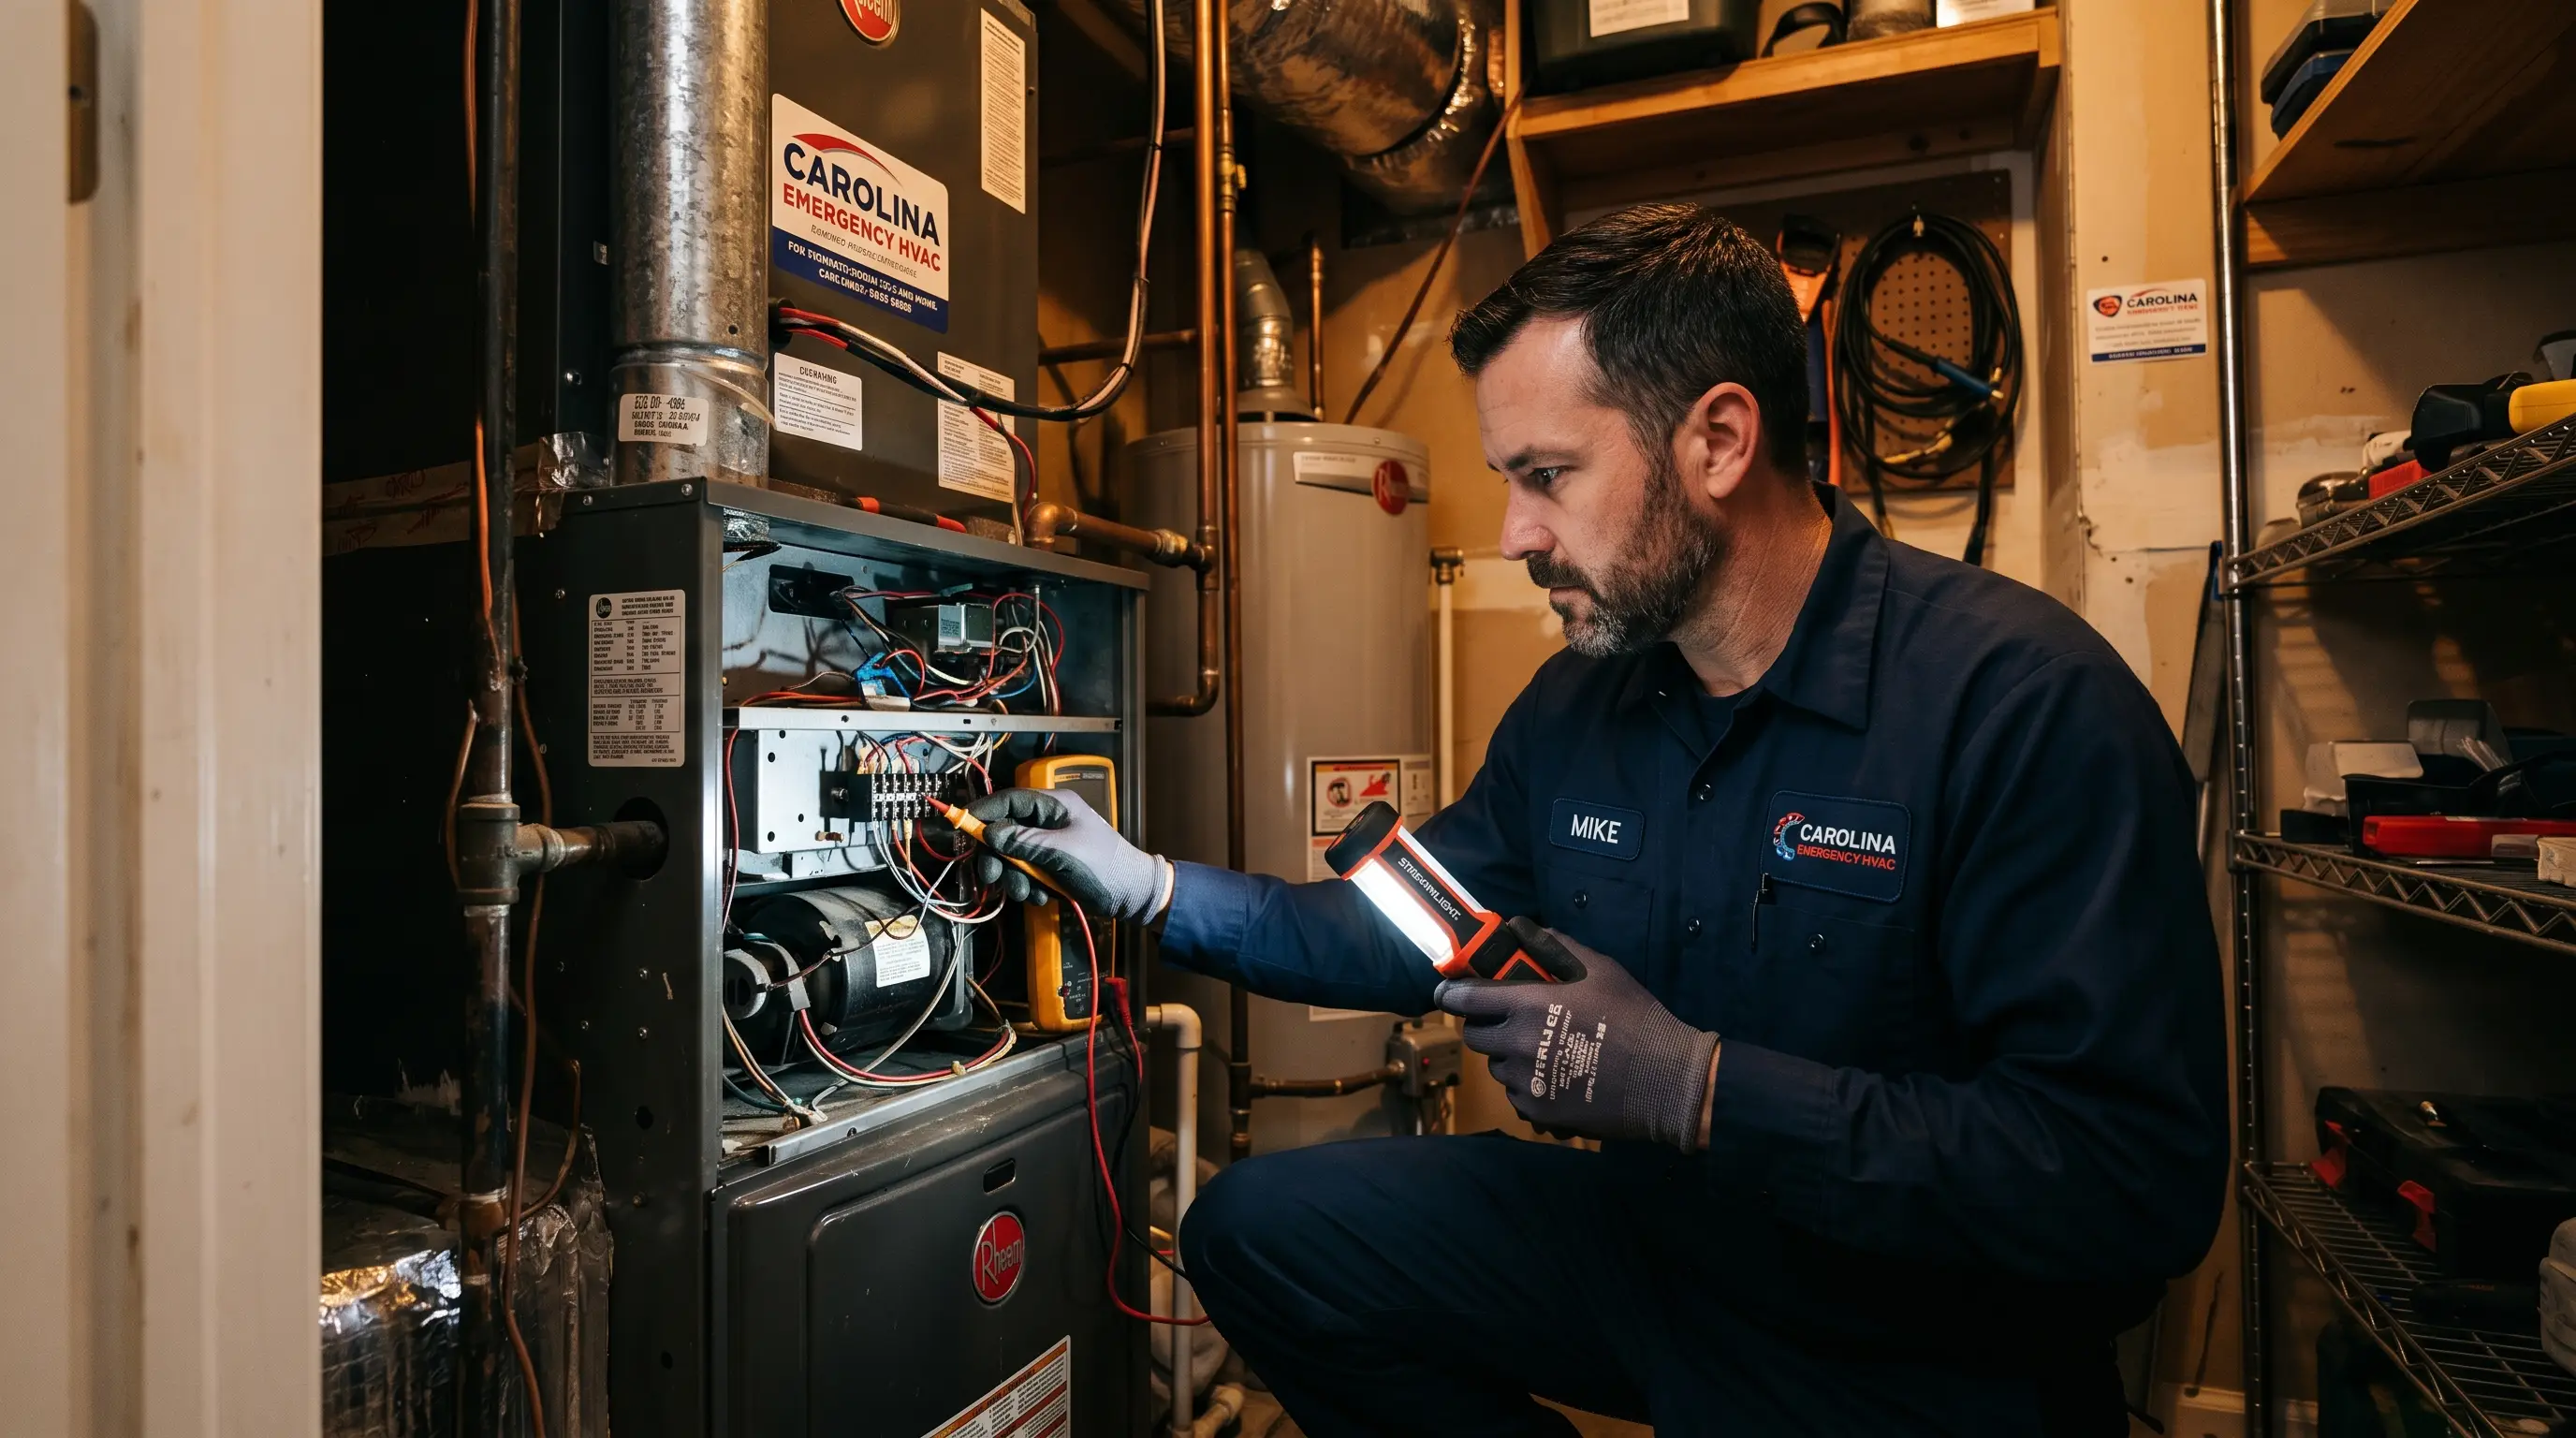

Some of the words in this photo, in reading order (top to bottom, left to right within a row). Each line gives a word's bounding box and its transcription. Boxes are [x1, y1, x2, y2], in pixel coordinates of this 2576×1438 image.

[783, 142, 941, 247] CAROLINA
[783, 183, 895, 251] EMERGENCY
[899, 236, 941, 272] HVAC
[2126, 292, 2198, 309] CAROLINA
[1571, 814, 1621, 844] MIKE
[1799, 823, 1896, 855] CAROLINA
[1861, 854, 1896, 871] HVAC
[980, 1221, 1023, 1292] Rheem
